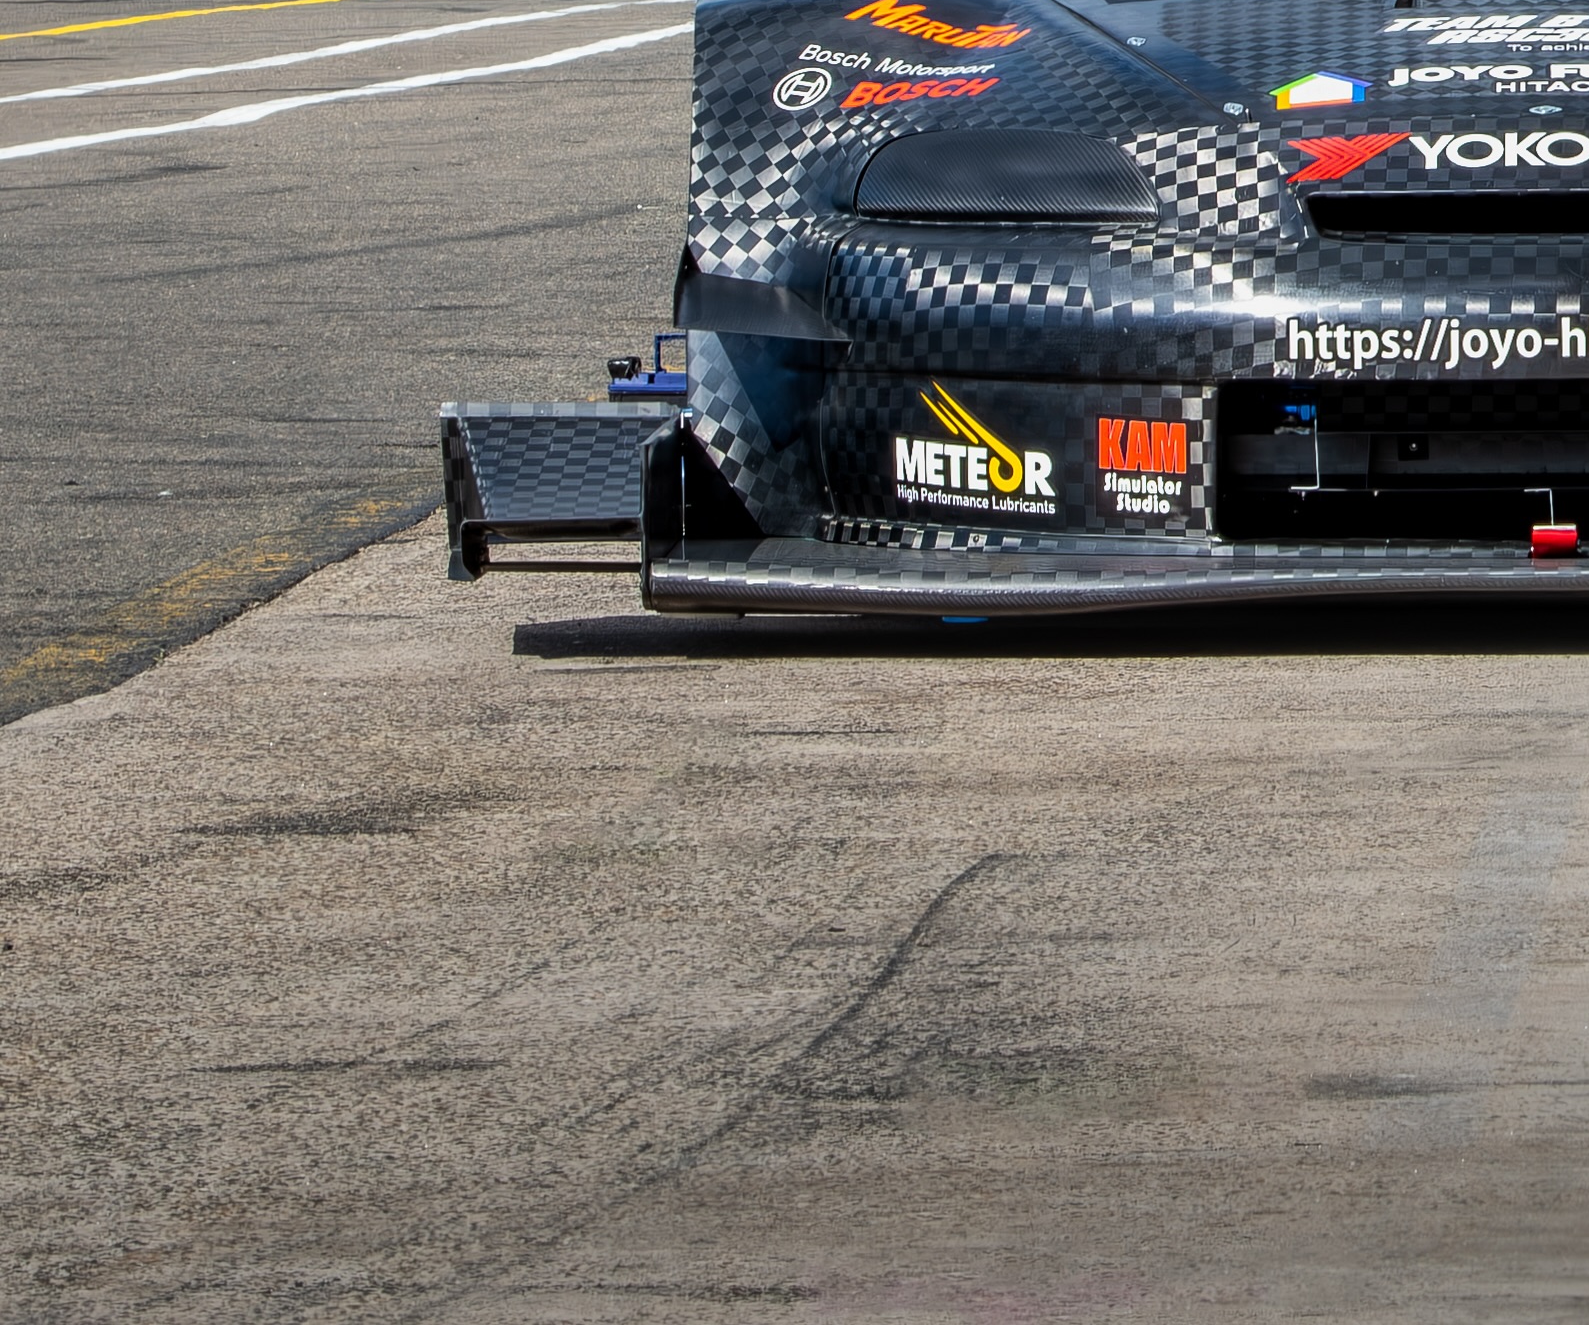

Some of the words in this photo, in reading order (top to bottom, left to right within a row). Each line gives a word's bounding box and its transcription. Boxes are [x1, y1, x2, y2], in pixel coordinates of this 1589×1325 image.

[1383, 14, 1538, 33] TEAM
[798, 44, 871, 69] Bosch
[875, 57, 995, 77] Motorsport
[1387, 63, 1534, 87] JOYO
[839, 78, 1001, 109] BOSCH
[1098, 417, 1187, 475] KAM
[895, 435, 1056, 497] METEOR
[897, 483, 919, 503] High
[920, 488, 989, 510] Performance
[991, 497, 1056, 516] Lubricants
[1103, 472, 1182, 496] Simulator
[1116, 492, 1172, 515] Studio
